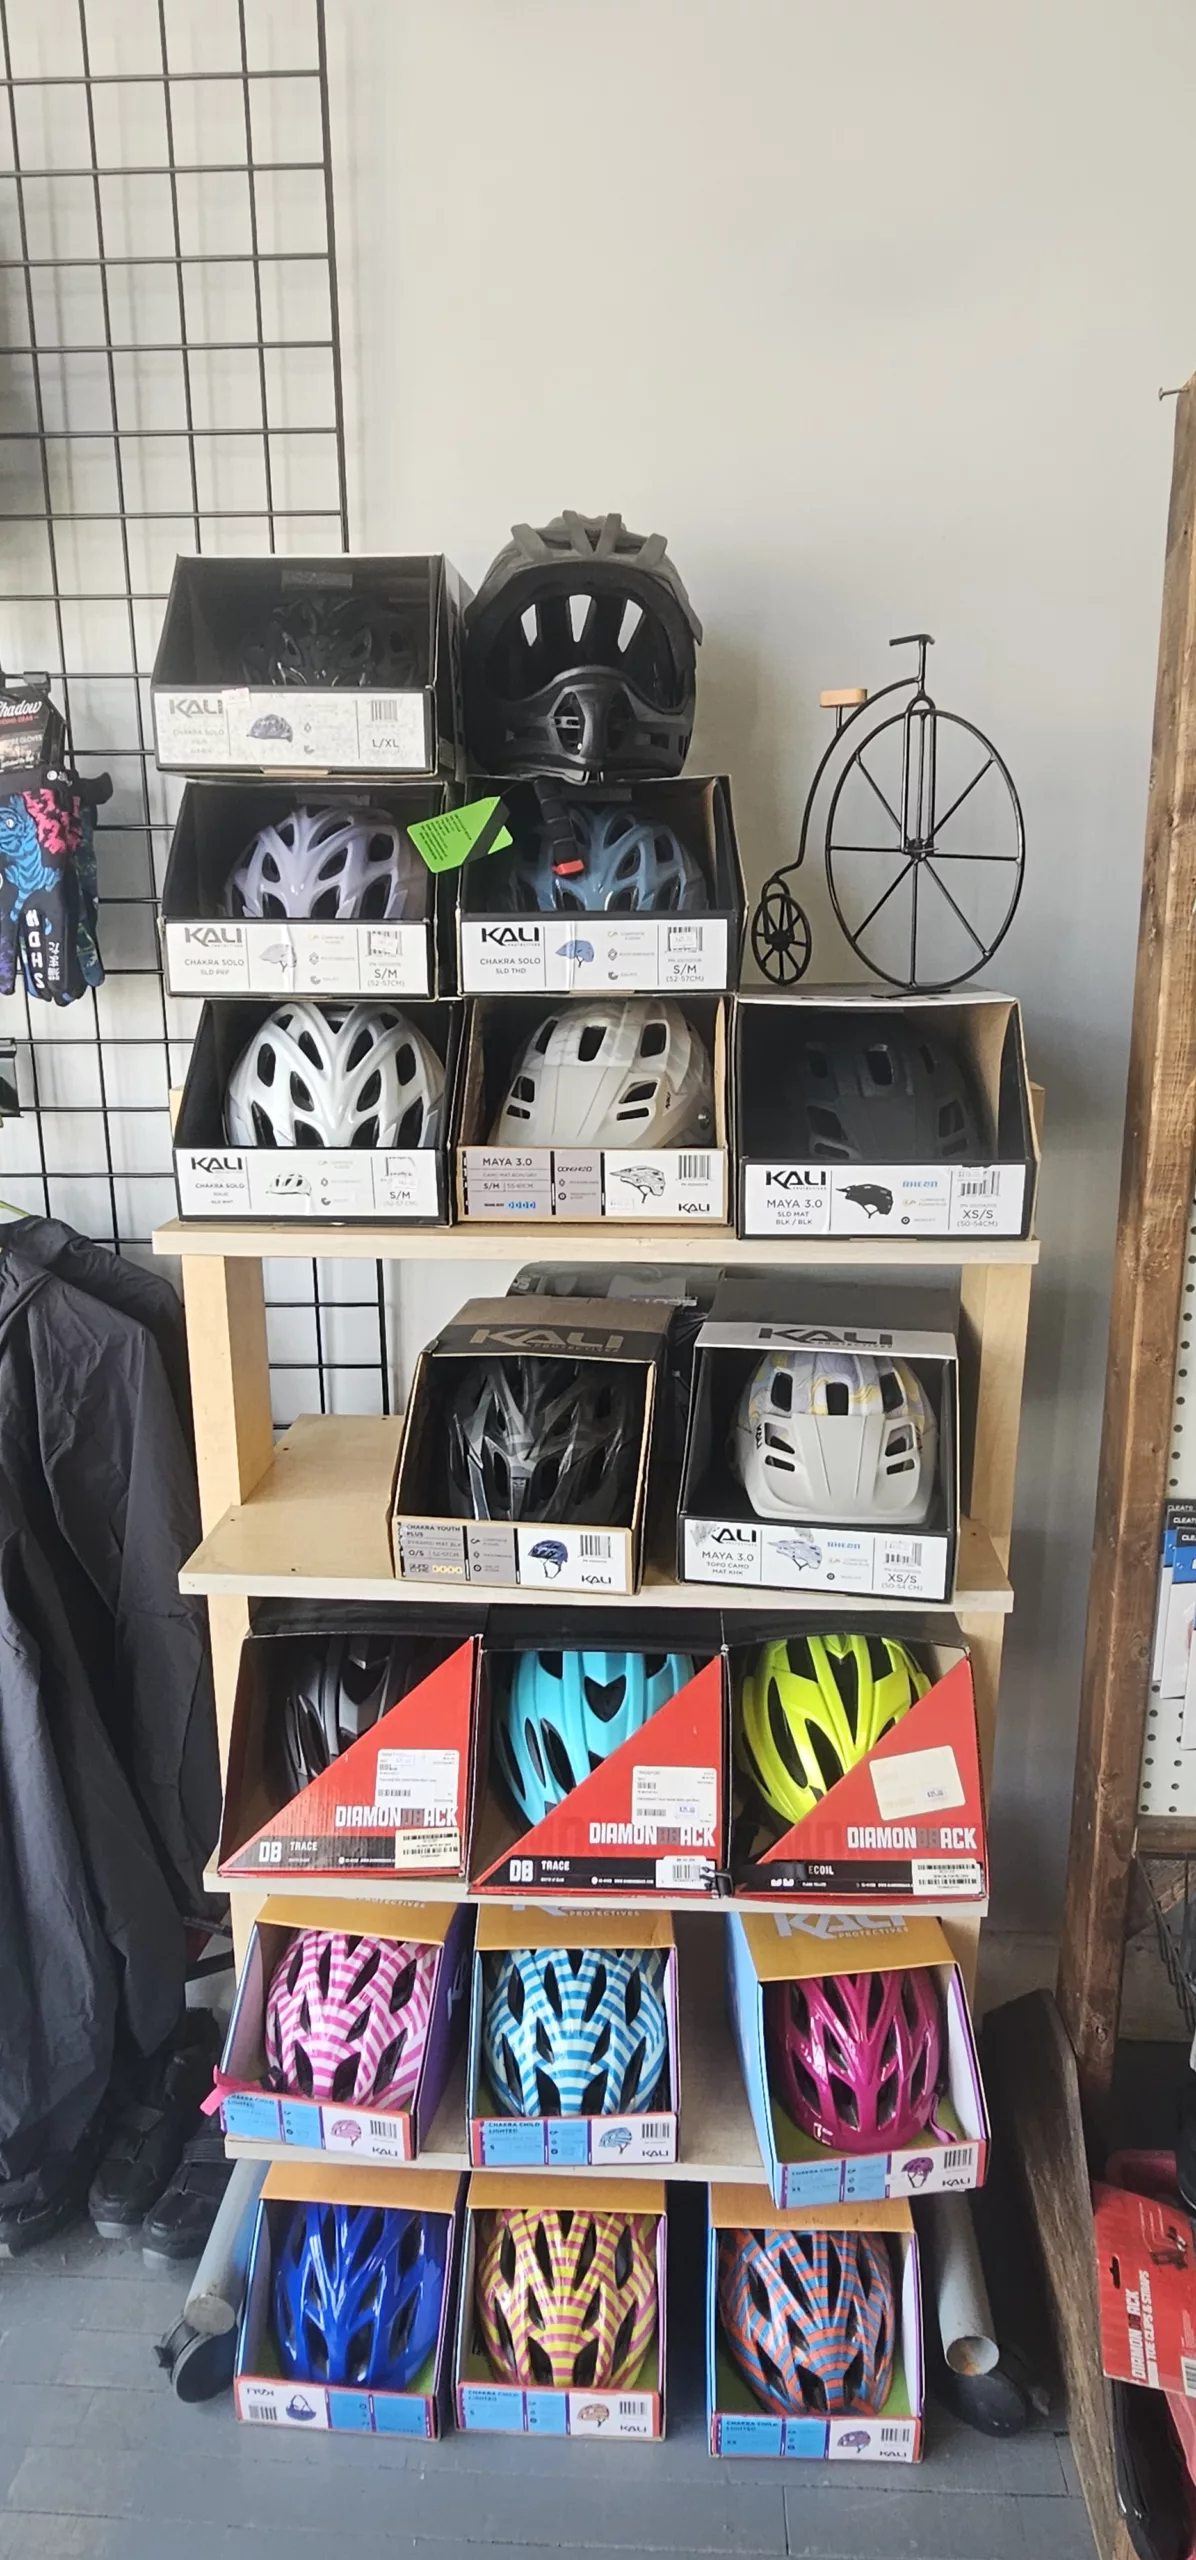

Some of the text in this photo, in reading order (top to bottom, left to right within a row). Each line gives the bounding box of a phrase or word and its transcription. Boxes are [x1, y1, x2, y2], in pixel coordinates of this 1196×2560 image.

[169, 699, 224, 718] KALI
[372, 738, 399, 748] L/XL
[184, 927, 243, 947] KALI
[481, 927, 540, 946] KALI
[184, 958, 245, 967] CHAKRA SOLO
[518, 957, 541, 965] SOLO
[374, 969, 397, 979] S/M
[673, 964, 697, 975] S/M
[191, 1157, 243, 1173] KALI
[482, 1158, 532, 1166] MAYA 3.0
[766, 1170, 826, 1189] KALI
[389, 1191, 410, 1200] S/M
[678, 1203, 710, 1213] KALI
[766, 1200, 823, 1208] MAYA 3.0
[963, 1209, 993, 1219] XS/S
[469, 1329, 623, 1347] KALI
[758, 1328, 893, 1345] KALI
[702, 1551, 754, 1561] MAYA 3.0
[581, 1575, 612, 1584] KALI
[888, 1573, 917, 1584] XS/S
[335, 1805, 459, 1827] DIAMONDBACK
[589, 1822, 716, 1847] DIAMONDBACK
[846, 1827, 977, 1849] DIAMONDBACK
[259, 1841, 318, 1862] DB TRACE
[509, 1860, 570, 1882] DB TRACE
[808, 1864, 834, 1875] ECOIL
[839, 1927, 909, 1938] PROTECTIVES
[372, 2147, 398, 2157] KALI
[942, 2178, 970, 2186] KALI
[1126, 2288, 1147, 2380] DIAMONDBACK
[620, 2424, 647, 2432] KALI
